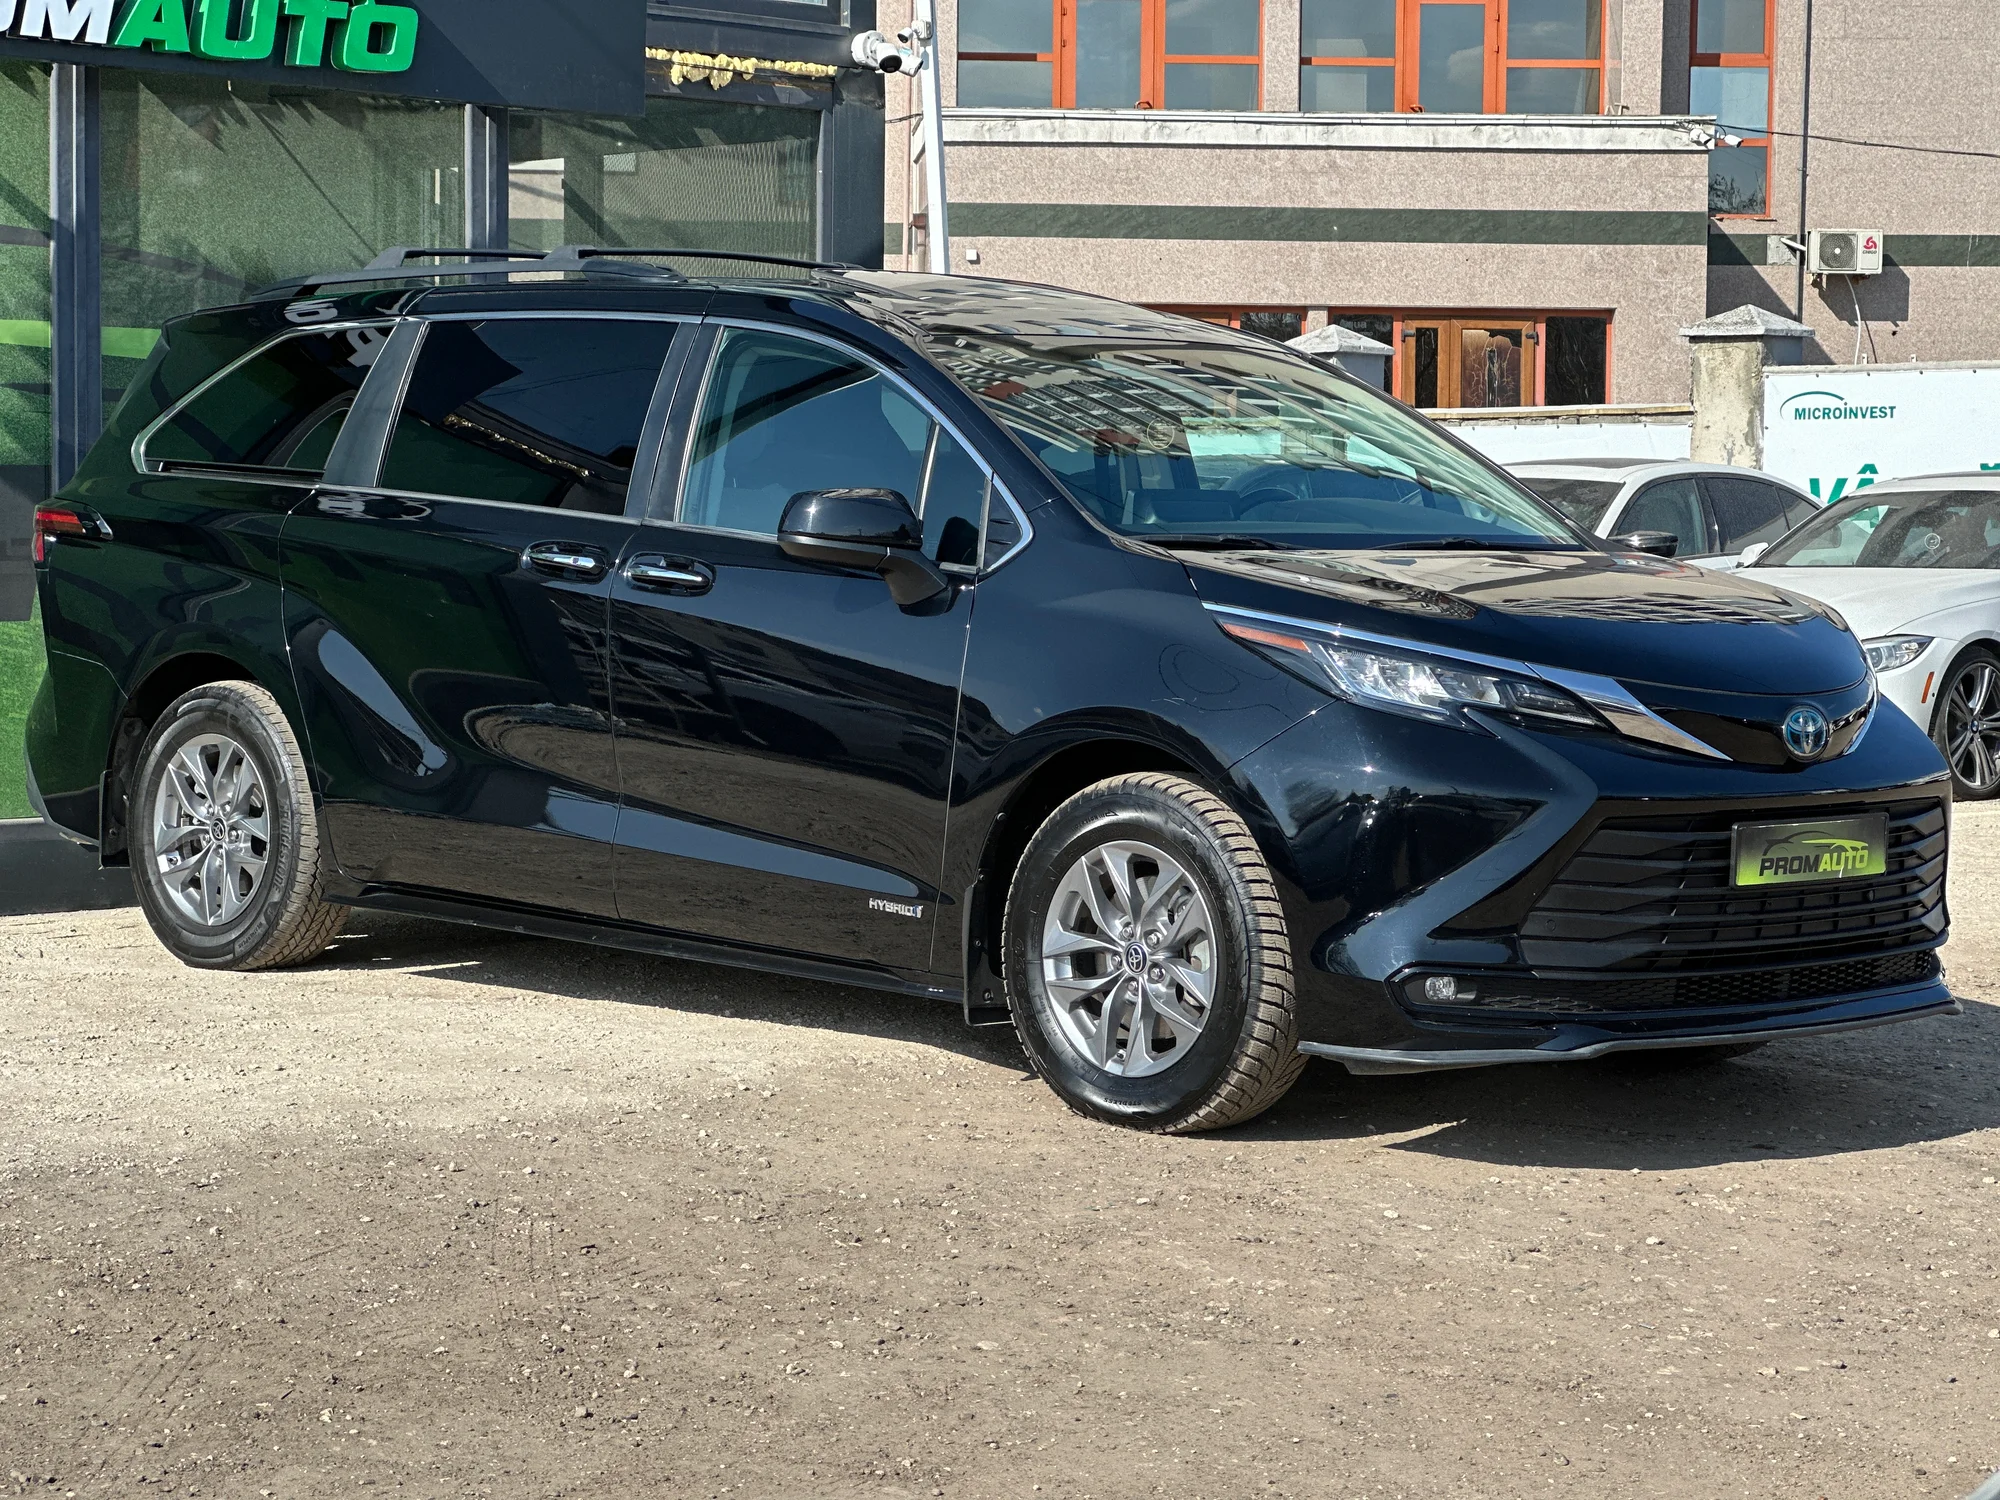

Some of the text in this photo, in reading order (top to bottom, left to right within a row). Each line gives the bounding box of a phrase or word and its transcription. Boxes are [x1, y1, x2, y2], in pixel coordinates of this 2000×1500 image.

[0, 0, 418, 72] MAUTO
[1759, 850, 1869, 877] PROMAUTO
[868, 897, 914, 917] HYBRID
